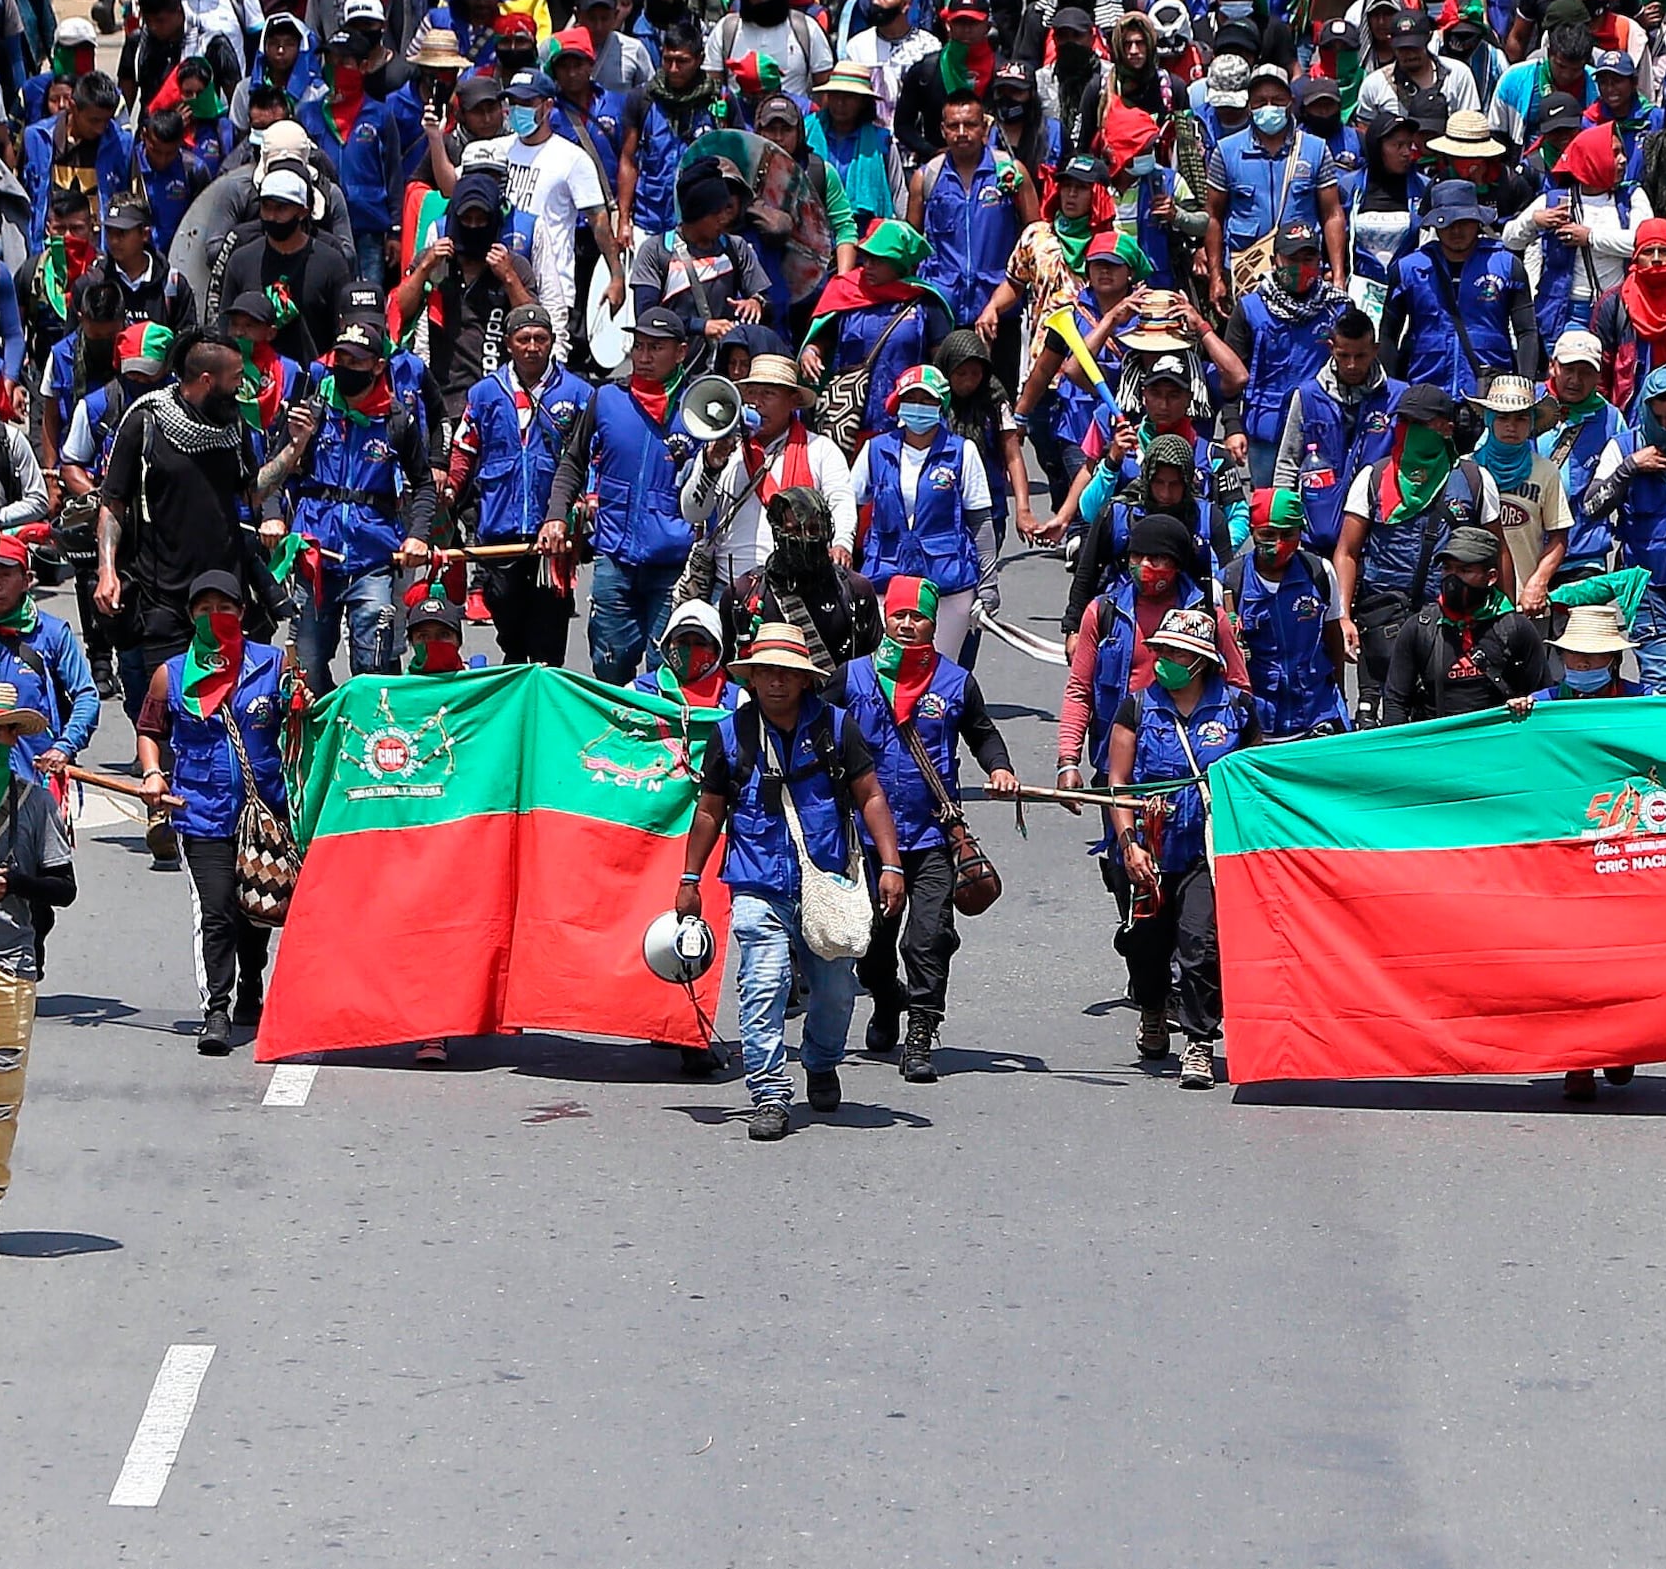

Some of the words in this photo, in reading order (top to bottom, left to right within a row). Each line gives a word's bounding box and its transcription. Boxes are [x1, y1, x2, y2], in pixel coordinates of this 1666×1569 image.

[377, 747, 406, 764] CRIC
[590, 769, 663, 793] ACIN
[1595, 857, 1629, 874] CRIC
